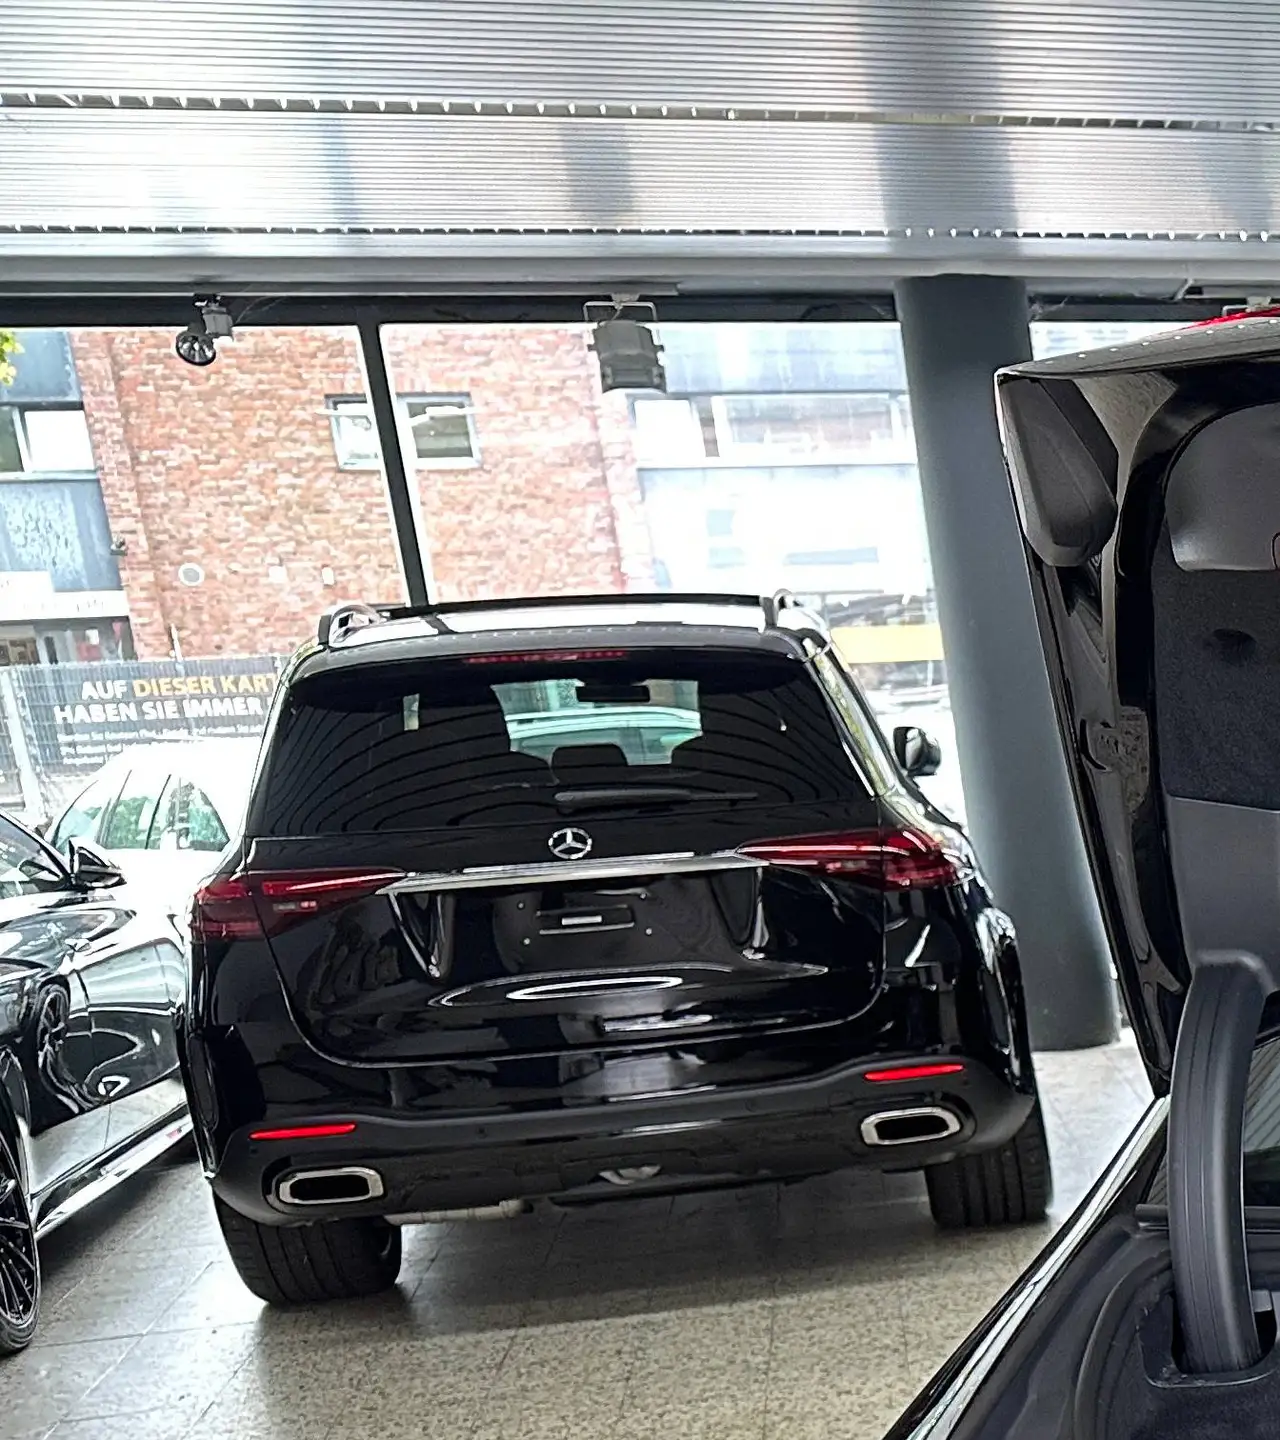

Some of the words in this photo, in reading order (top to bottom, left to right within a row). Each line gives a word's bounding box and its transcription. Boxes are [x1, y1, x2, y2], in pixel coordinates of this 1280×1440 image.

[82, 681, 129, 700] AUF
[134, 676, 217, 697] DIESER
[55, 703, 138, 724] HABEN
[142, 701, 181, 719] SIE
[184, 698, 264, 718] IMMER
